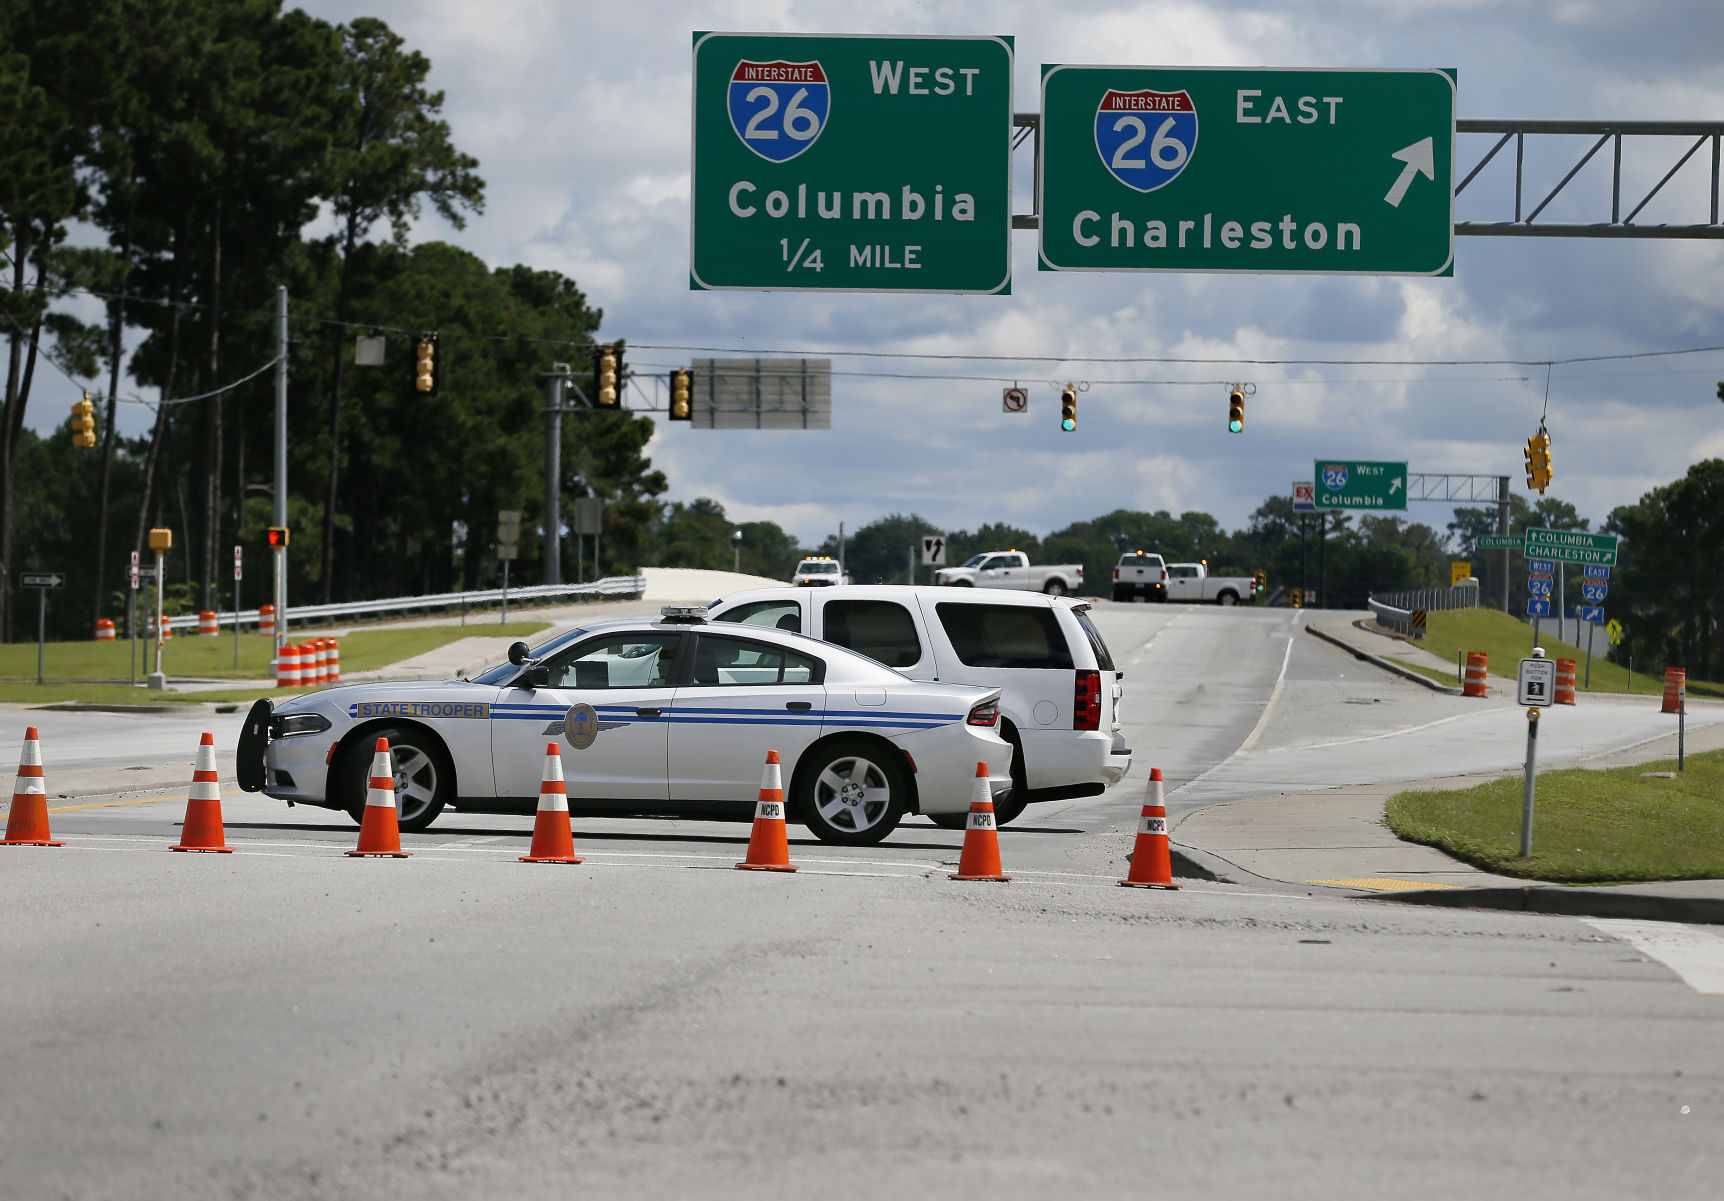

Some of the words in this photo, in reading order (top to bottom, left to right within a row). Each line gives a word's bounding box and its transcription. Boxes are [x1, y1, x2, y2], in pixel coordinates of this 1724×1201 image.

[744, 67, 814, 81] INTERSTATE
[870, 60, 980, 96] WEST
[1111, 96, 1181, 110] INTERSTATE
[1236, 89, 1343, 125] EAST
[744, 86, 820, 140] 26
[1111, 115, 1187, 170] 26
[728, 180, 975, 221] Columbia
[1072, 209, 1361, 250] Charleston
[780, 238, 824, 272] 1/4
[849, 244, 922, 269] MILE
[1356, 465, 1384, 476] WEST
[1326, 471, 1346, 486] 26
[1322, 494, 1383, 505] Columbia
[1480, 537, 1522, 546] COLUMBIA
[1539, 532, 1594, 547] COLUMBIA
[1529, 545, 1600, 562] CHARLESTON
[1533, 561, 1552, 571] WEST
[1588, 566, 1606, 577] EAST
[1532, 581, 1549, 594] 26
[1586, 587, 1604, 599] 26
[363, 704, 408, 716] STATE
[411, 704, 484, 717] TROOPER
[761, 803, 780, 816] NCPD
[972, 813, 991, 827] NCPD
[1147, 819, 1166, 832] NCPD
